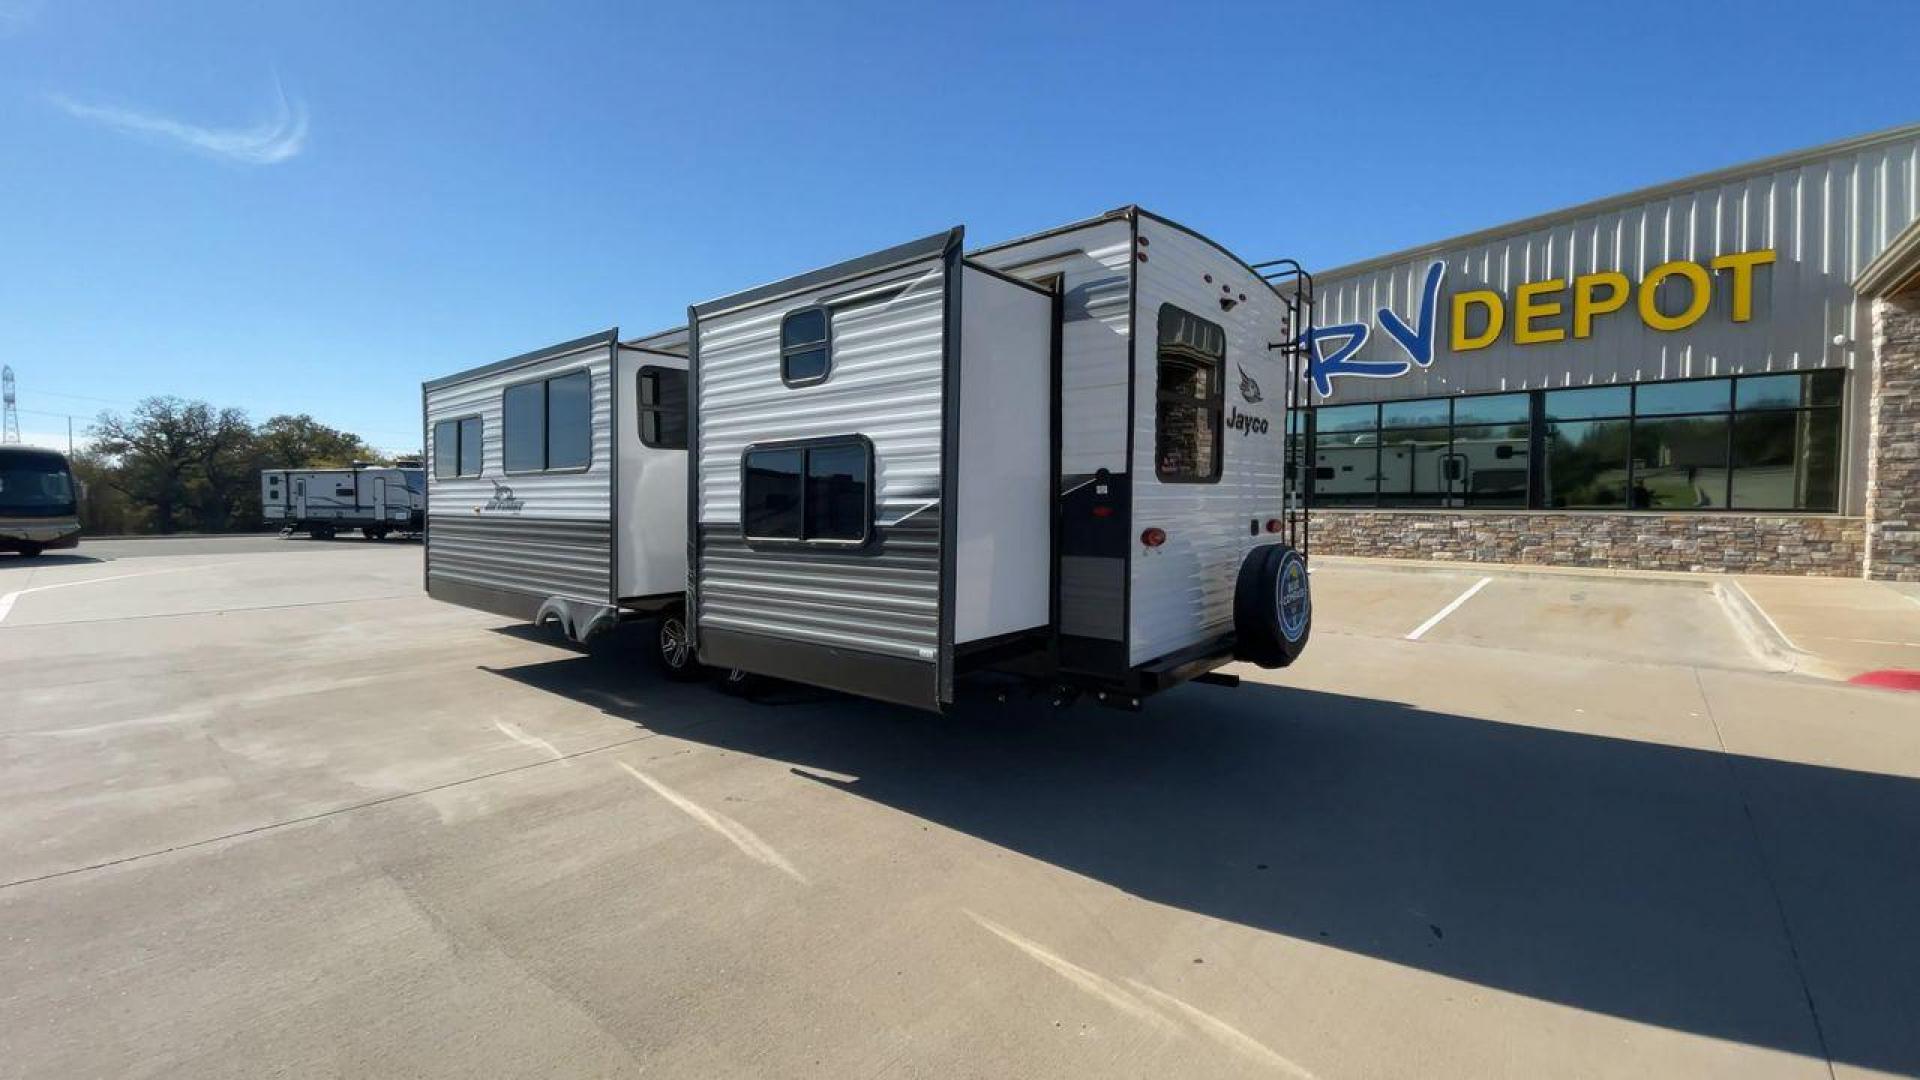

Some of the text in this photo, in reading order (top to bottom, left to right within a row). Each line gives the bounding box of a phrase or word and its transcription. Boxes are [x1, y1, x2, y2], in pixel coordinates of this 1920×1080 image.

[1299, 248, 1777, 398] RV DEPOT
[1226, 406, 1269, 437] Jayco
